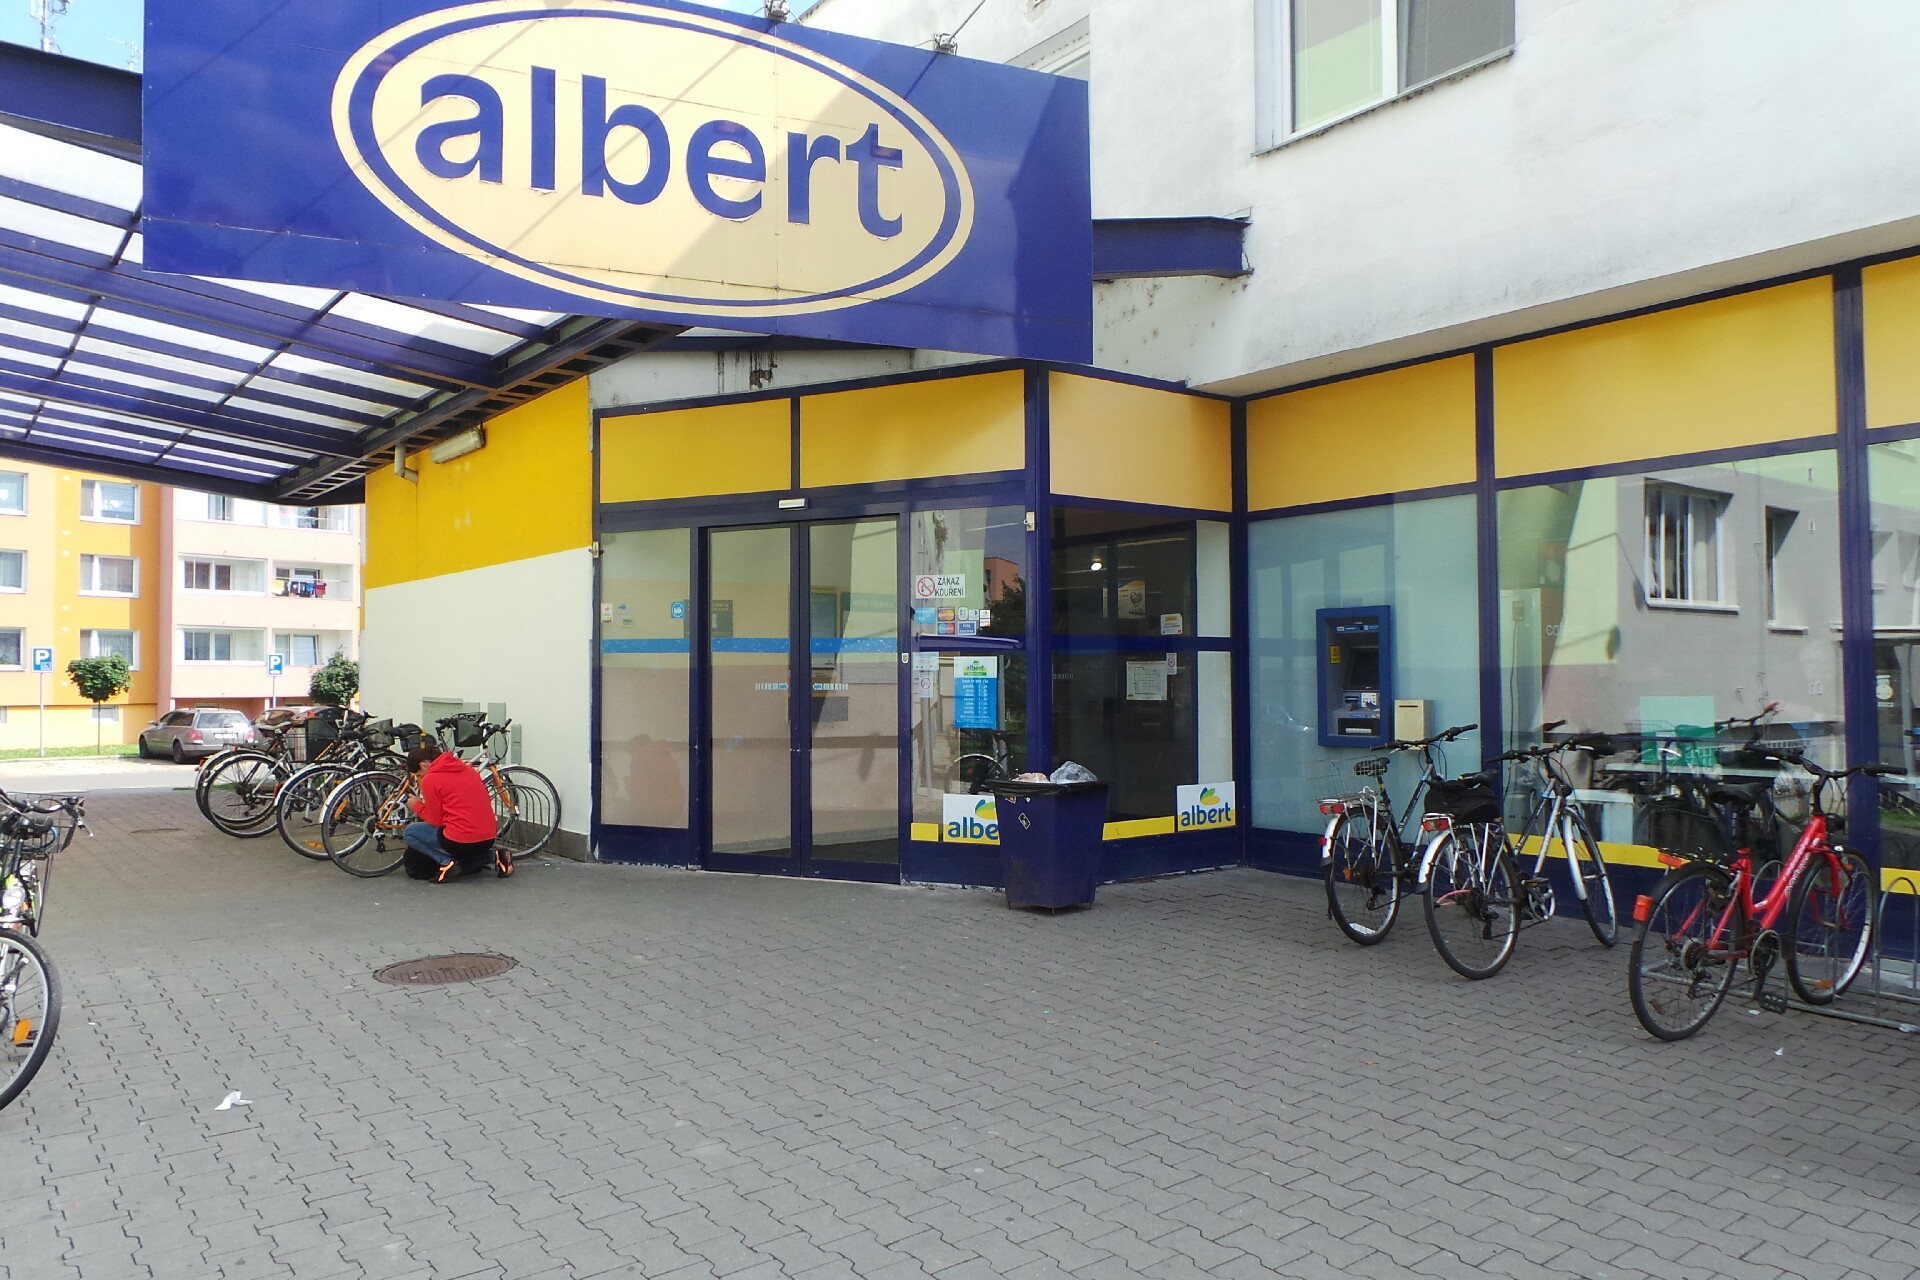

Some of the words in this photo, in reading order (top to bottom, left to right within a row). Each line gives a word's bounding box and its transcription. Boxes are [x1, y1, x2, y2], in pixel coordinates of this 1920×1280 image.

[414, 65, 904, 240] albert
[934, 586, 964, 597] KOUŘENÍ
[35, 649, 50, 665] P
[270, 655, 281, 670] P
[1180, 801, 1232, 827] albert
[947, 816, 999, 841] albe
